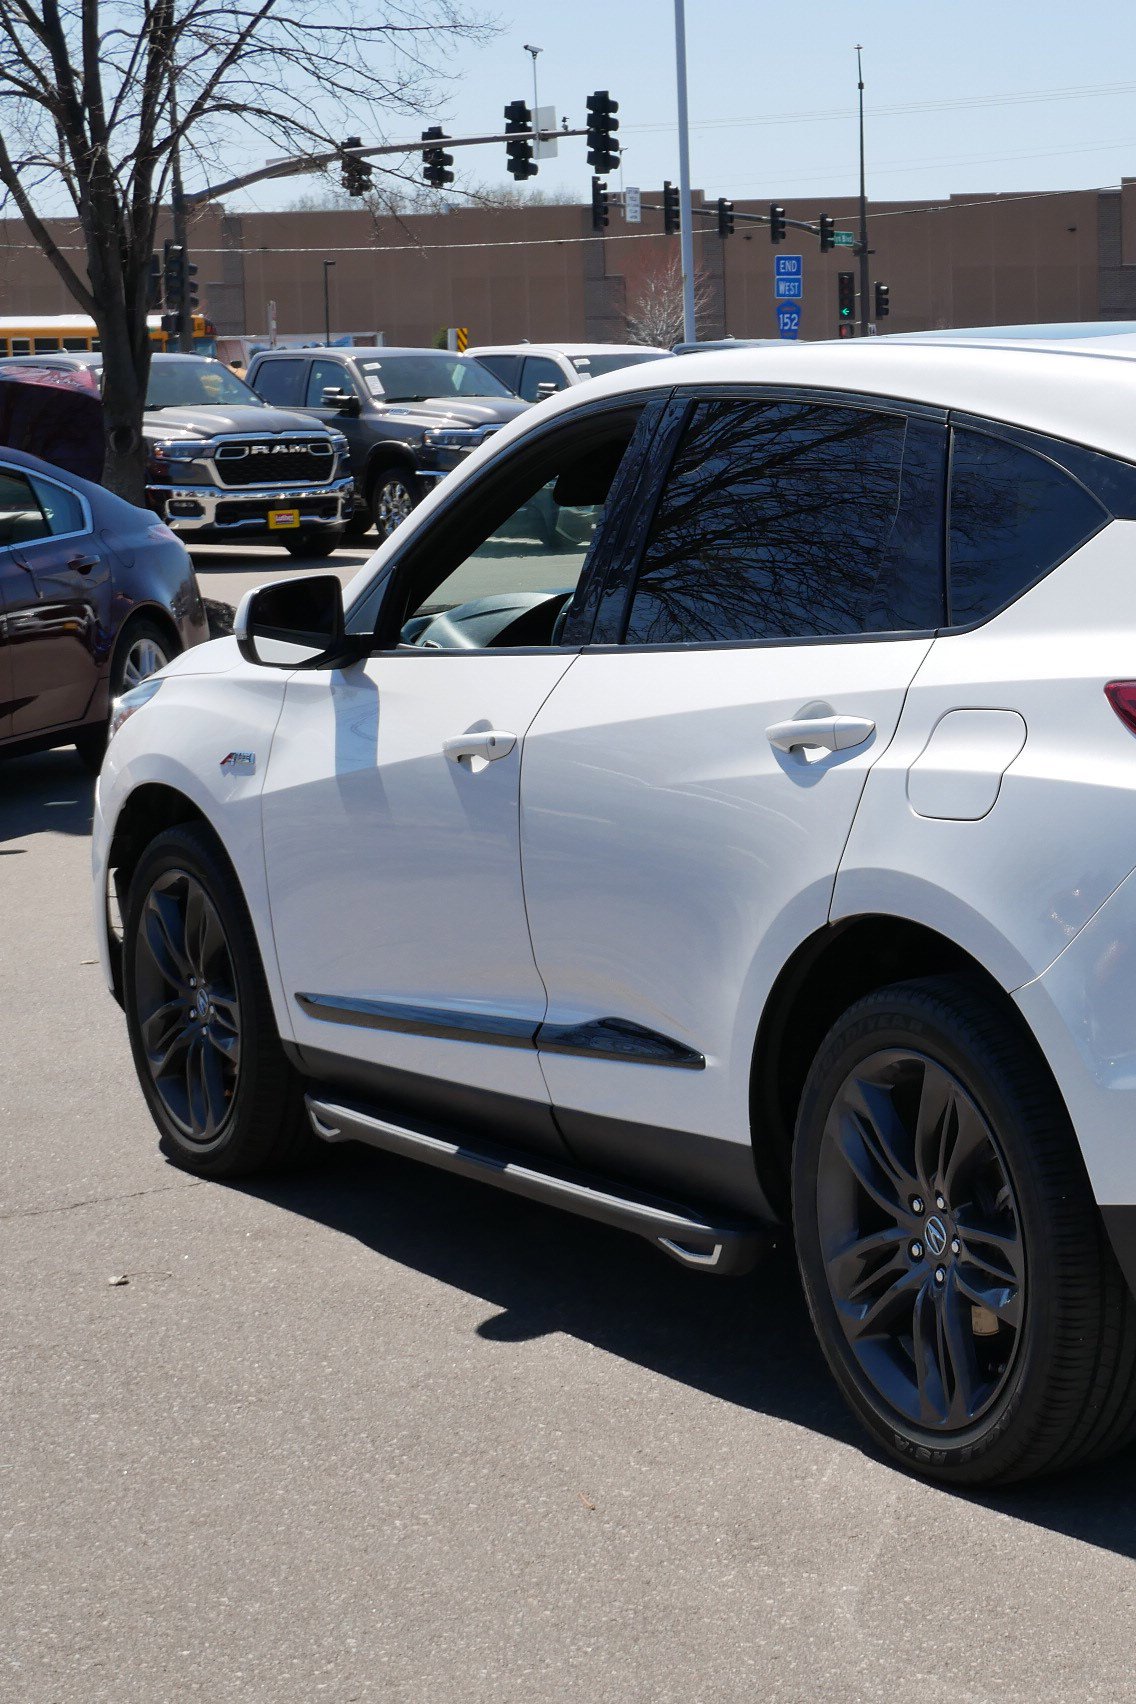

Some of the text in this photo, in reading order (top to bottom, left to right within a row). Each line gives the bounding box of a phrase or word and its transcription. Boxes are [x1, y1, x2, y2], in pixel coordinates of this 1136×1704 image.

[780, 260, 797, 272] END
[778, 281, 799, 295] WEST
[779, 313, 798, 330] 152
[251, 444, 307, 455] RAM
